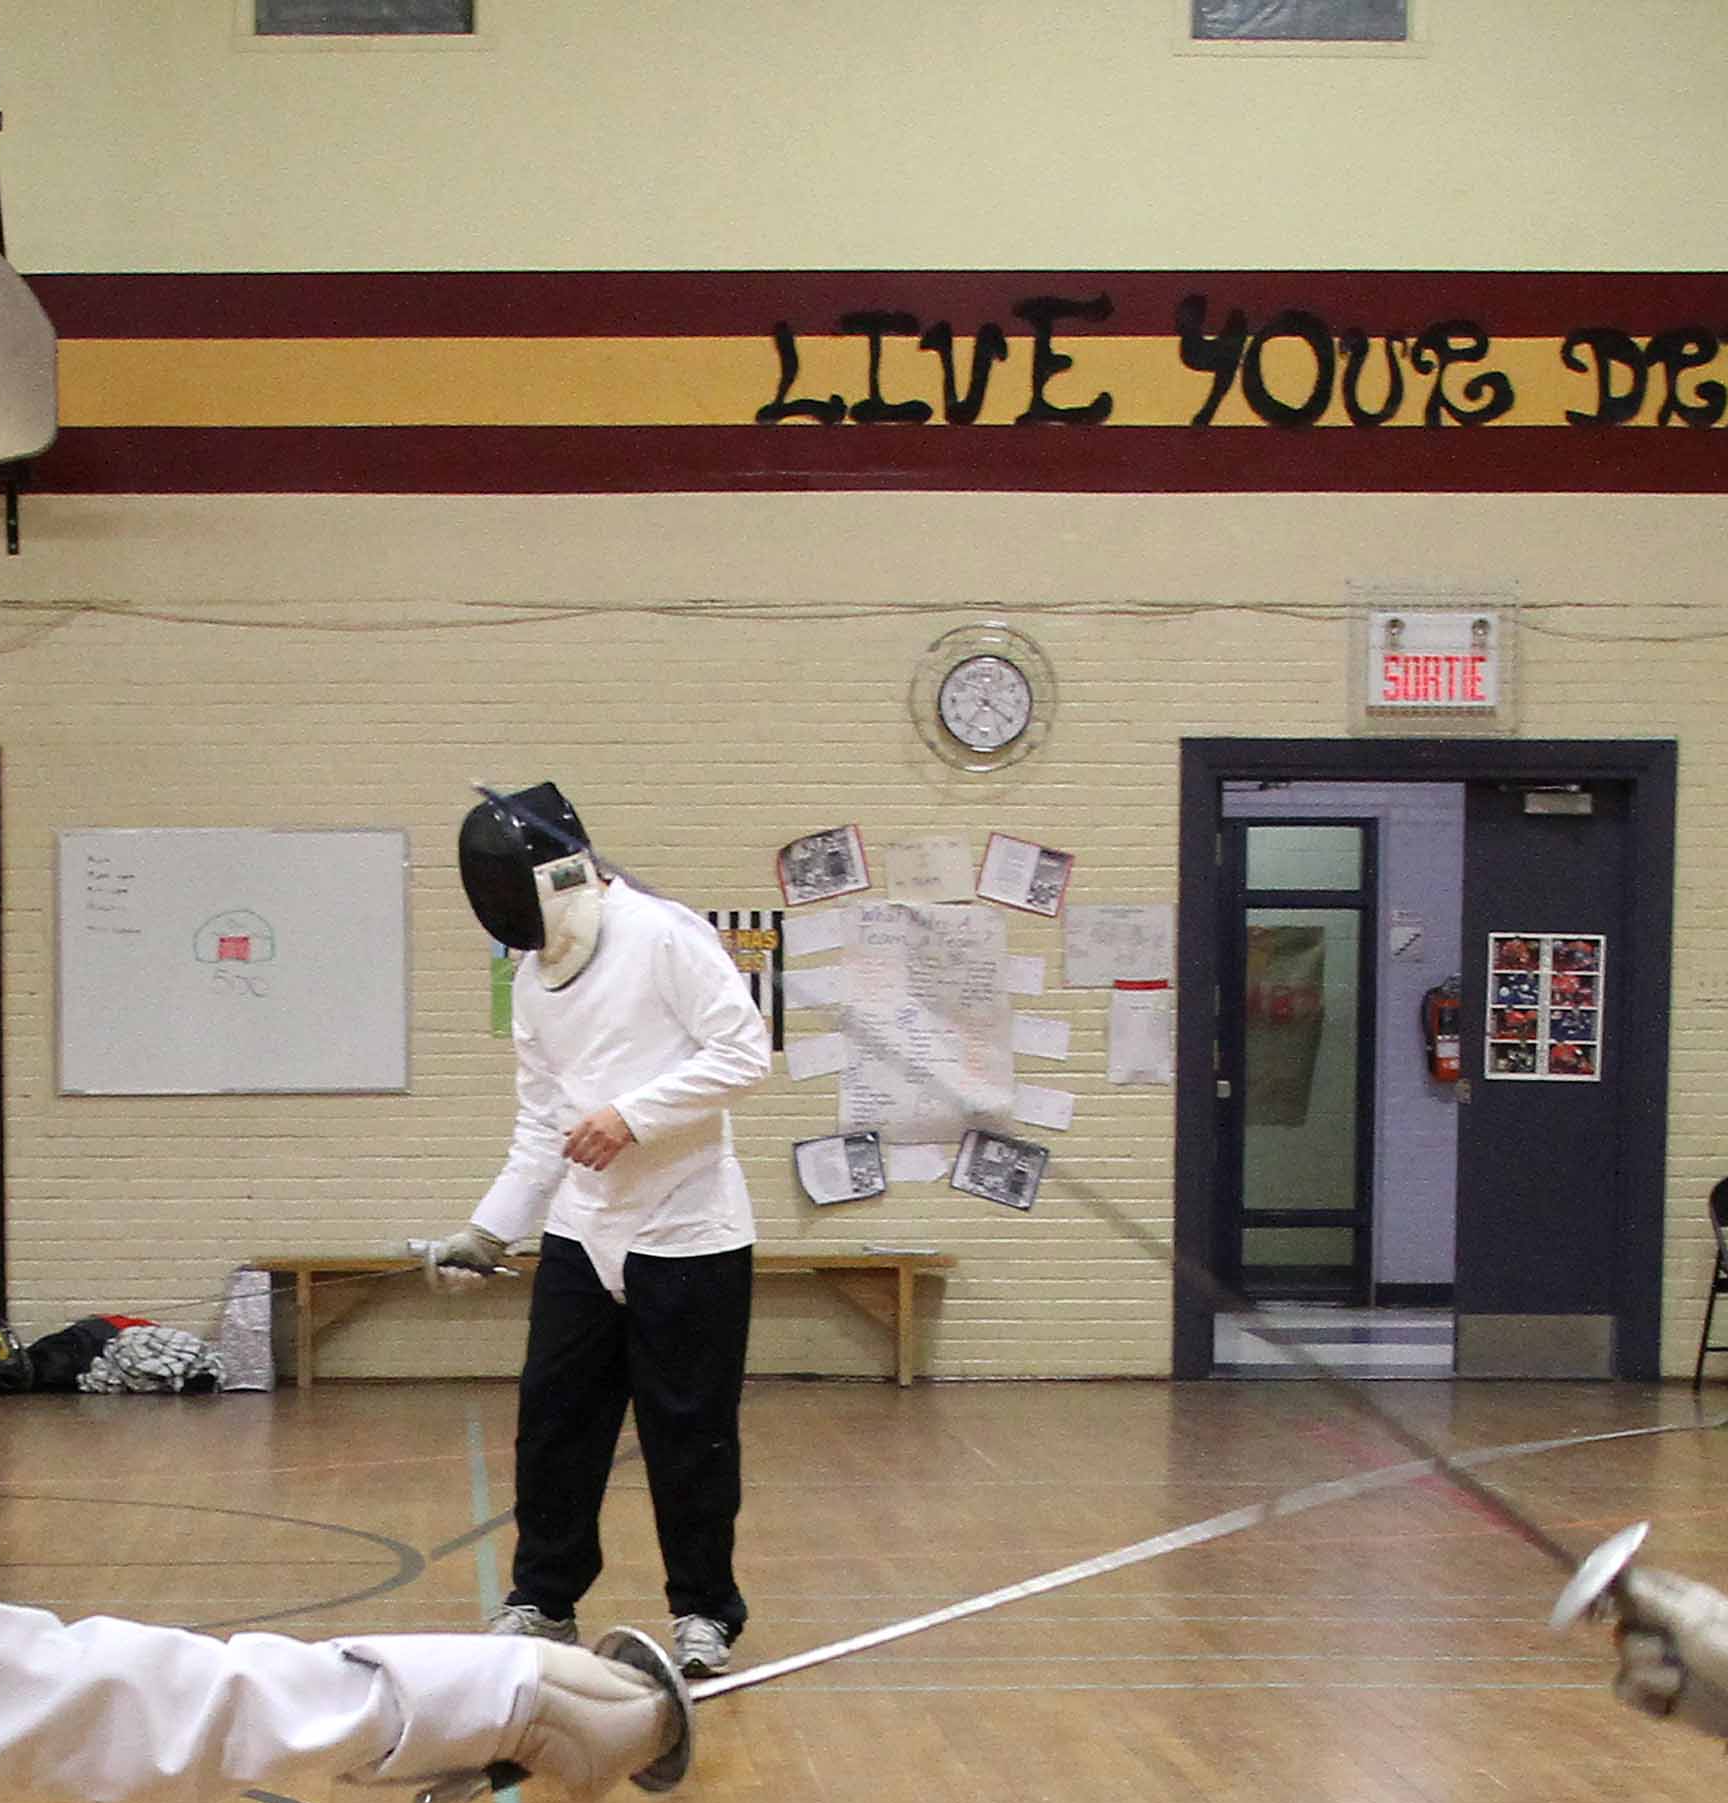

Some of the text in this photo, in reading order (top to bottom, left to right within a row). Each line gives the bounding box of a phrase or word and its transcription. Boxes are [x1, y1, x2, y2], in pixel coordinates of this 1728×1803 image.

[755, 293, 1113, 426] LIVE
[1176, 294, 1514, 427] YOUR
[1382, 655, 1488, 701] SORTIE
